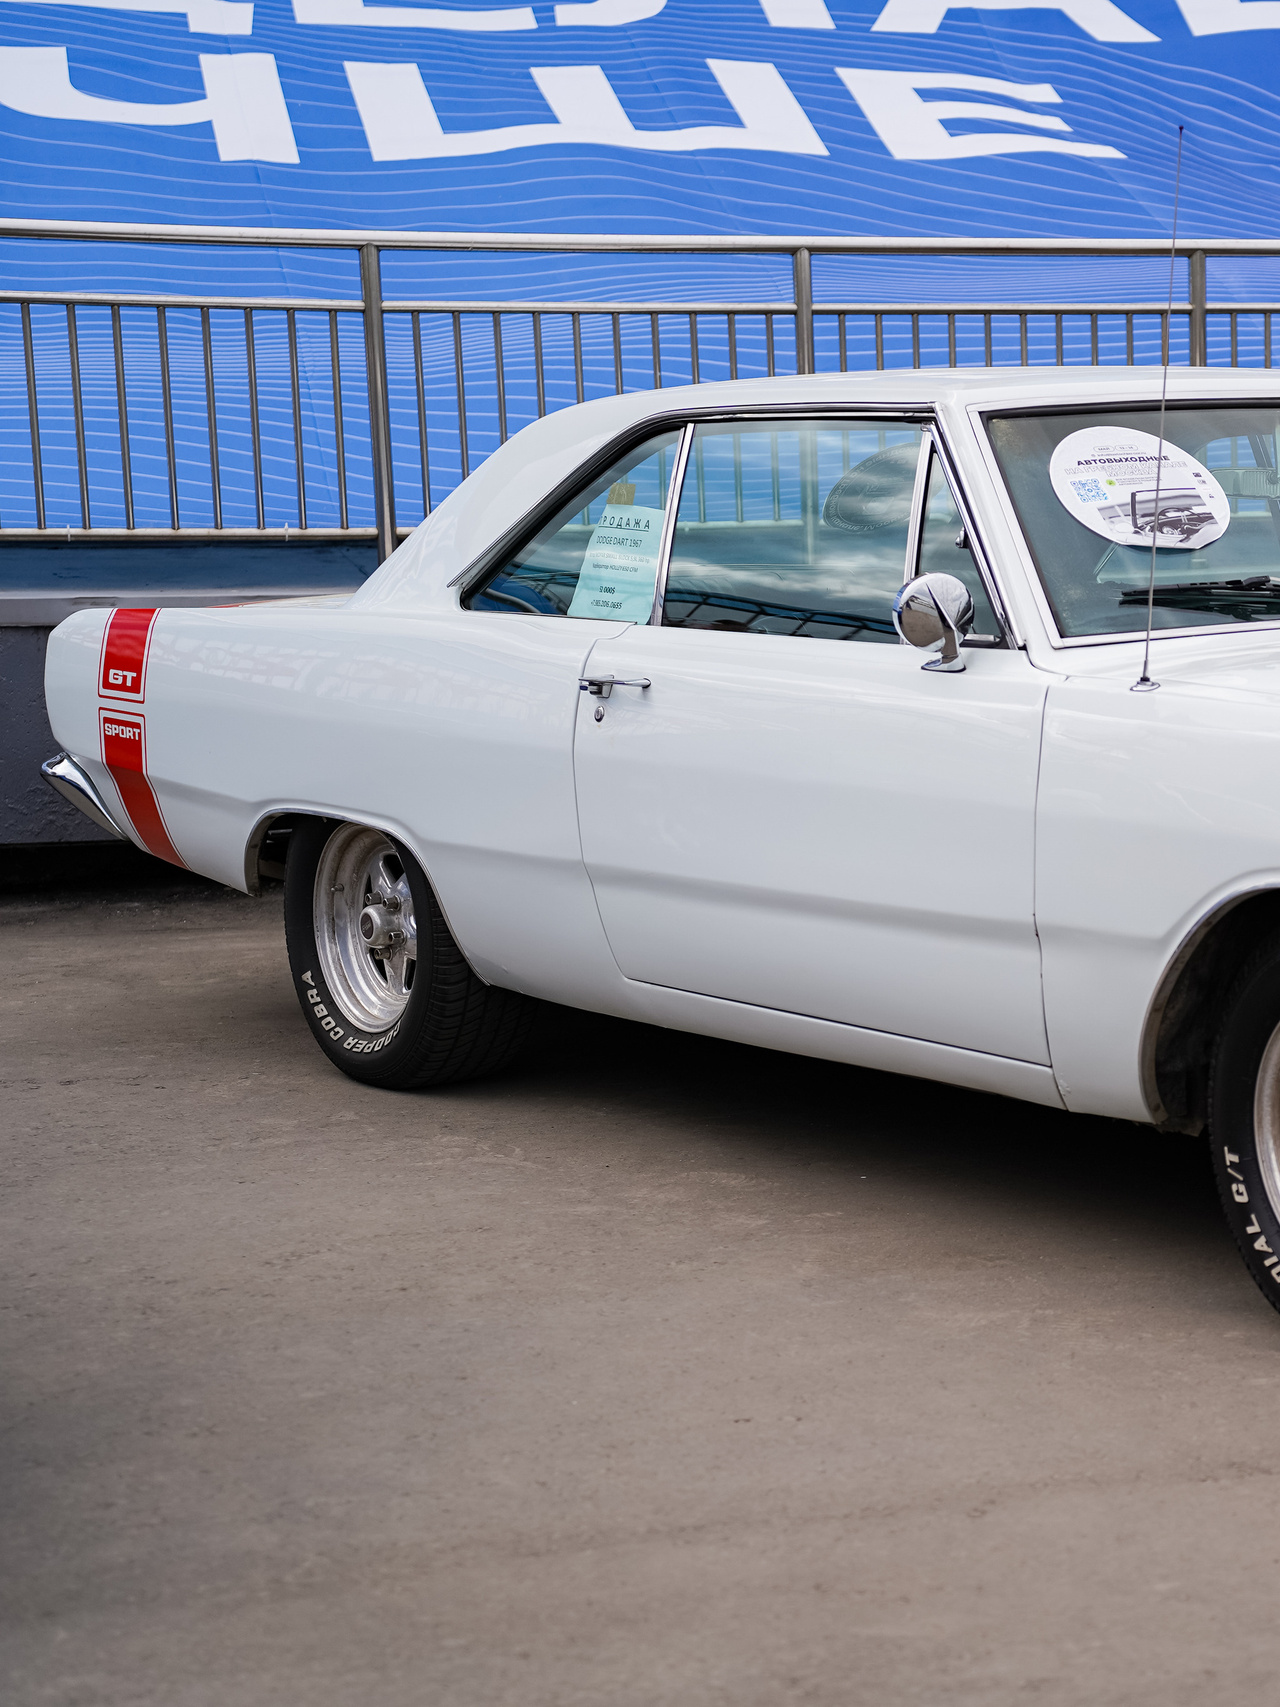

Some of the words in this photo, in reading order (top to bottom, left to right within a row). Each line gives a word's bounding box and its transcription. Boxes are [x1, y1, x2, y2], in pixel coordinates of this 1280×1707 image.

[1077, 455, 1171, 466] АВТОВЫХОДНЫЕ
[596, 535, 613, 545] DODGE
[613, 536, 629, 546] DART
[629, 538, 643, 548] 1967
[108, 668, 137, 687] GT
[104, 723, 141, 741] SPORT
[301, 969, 346, 1041] COBRA
[1223, 1146, 1250, 1204] G/T
